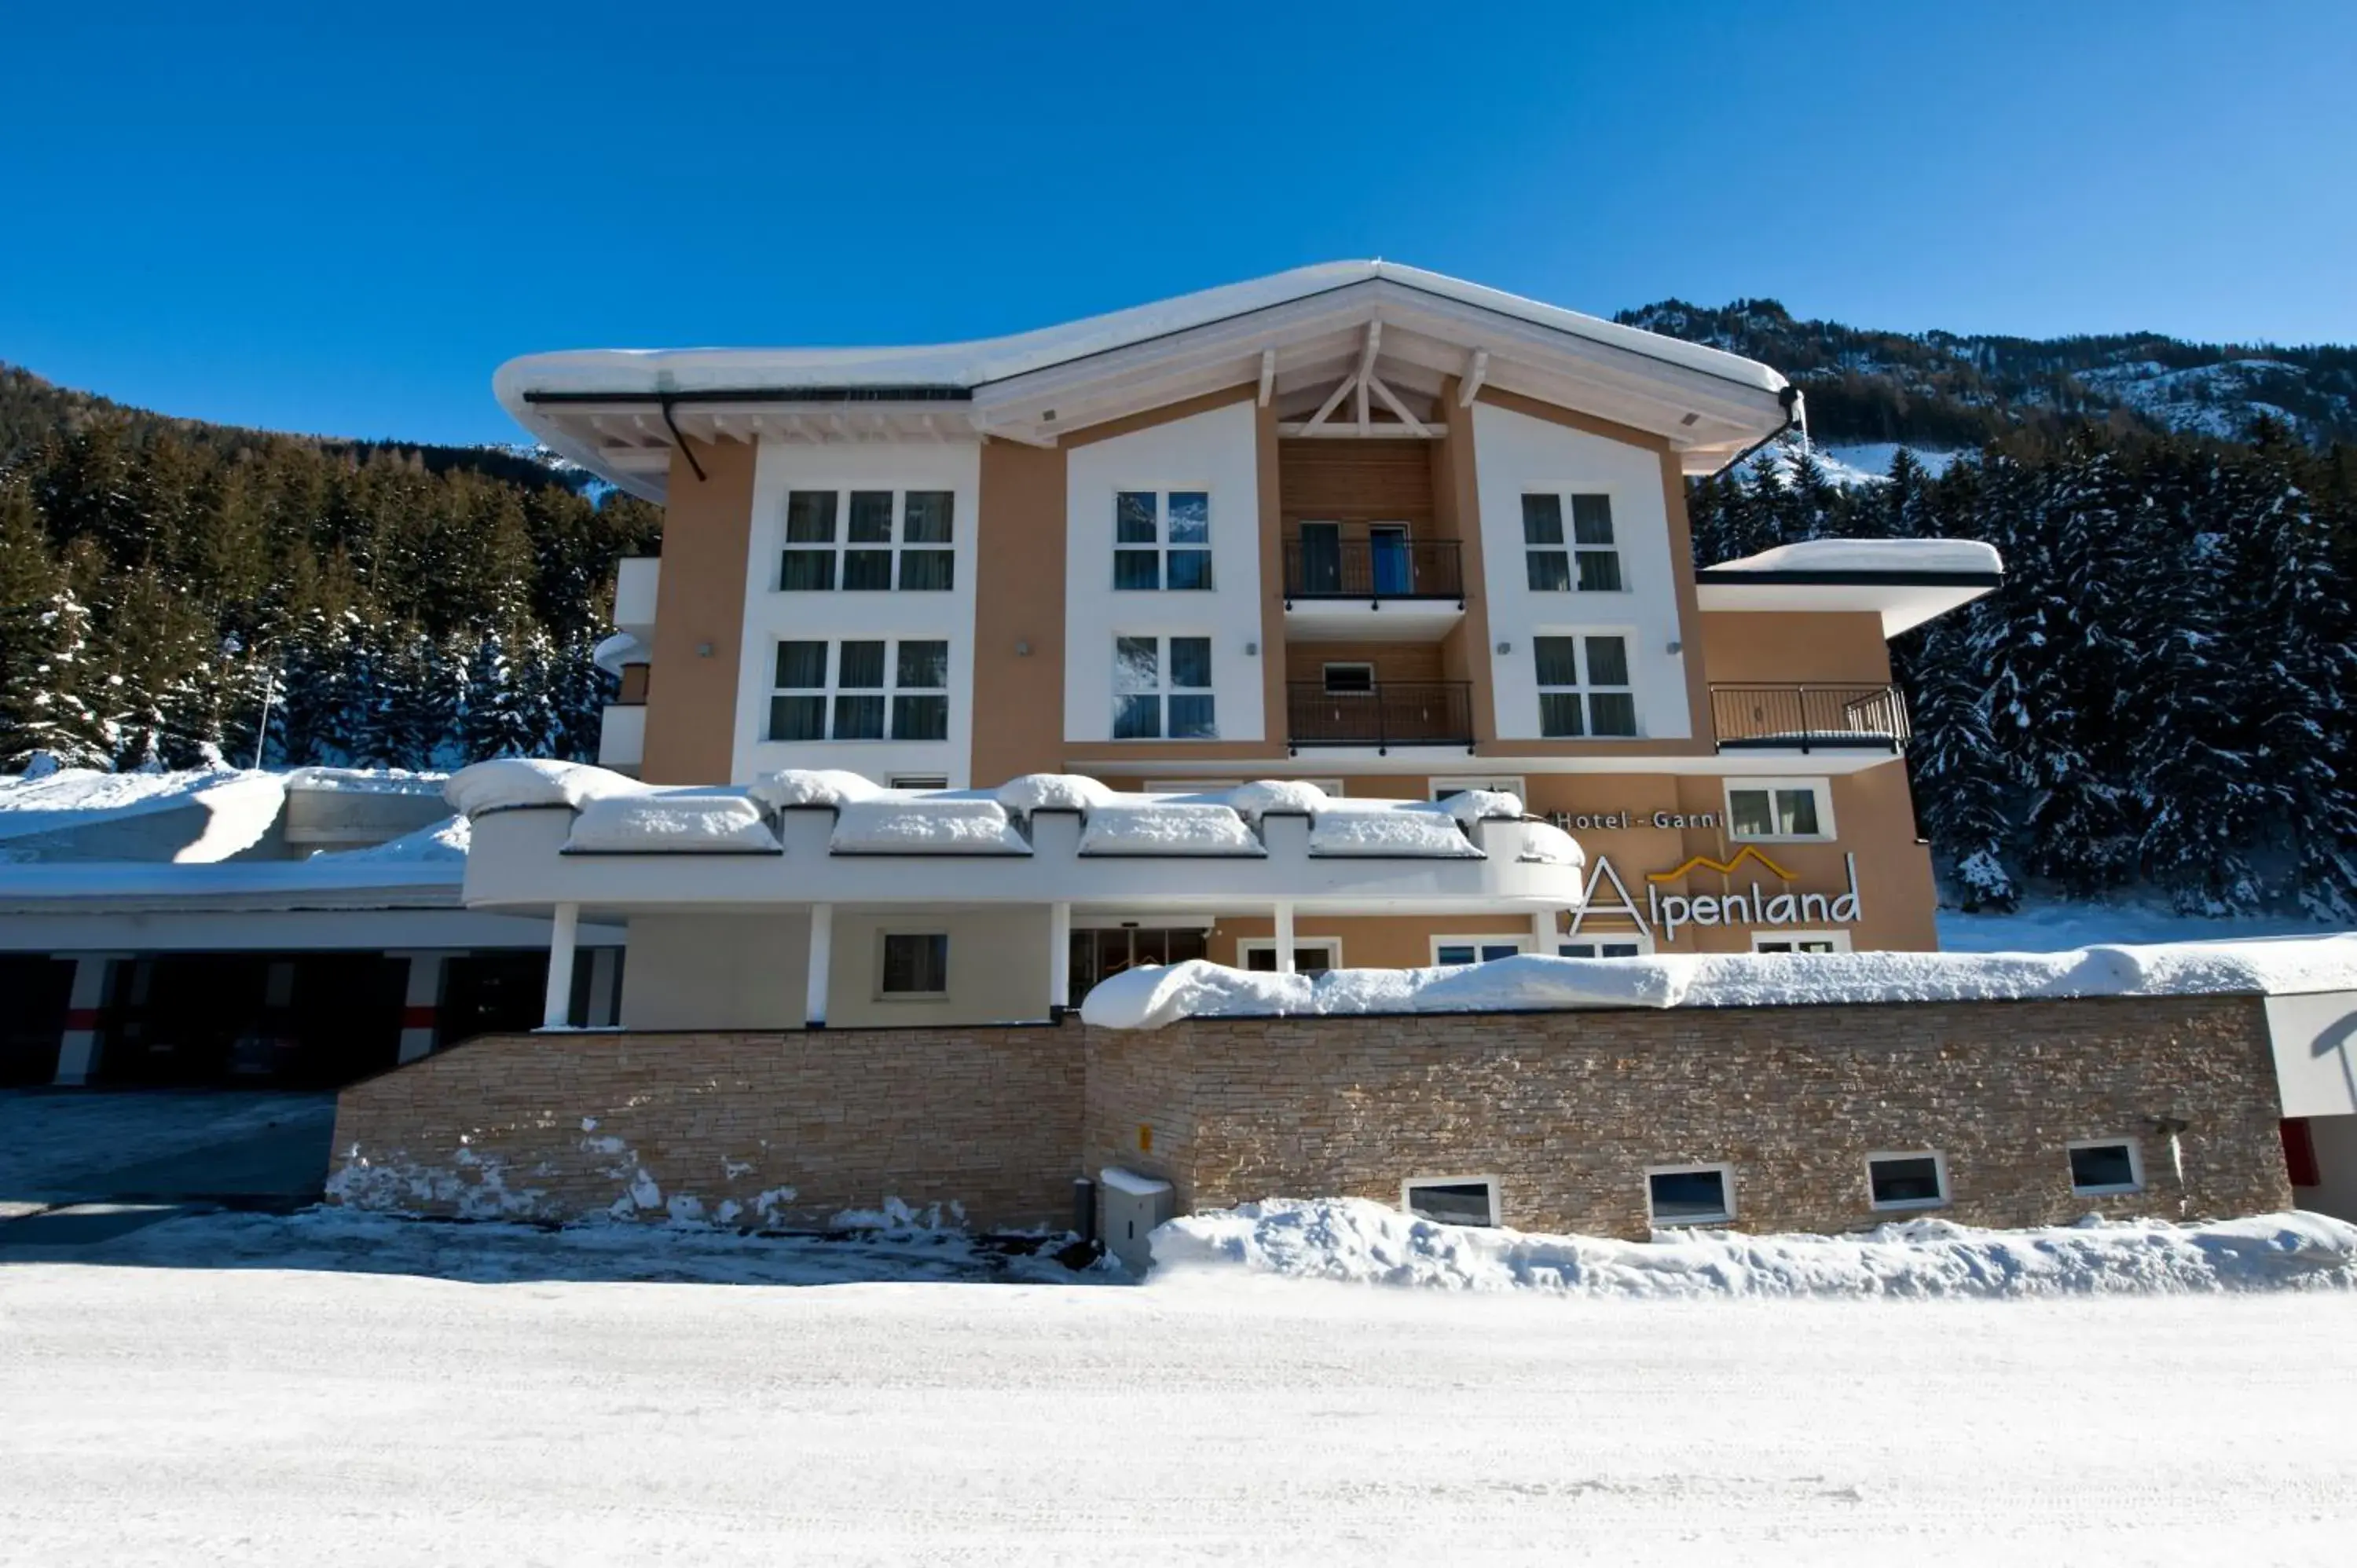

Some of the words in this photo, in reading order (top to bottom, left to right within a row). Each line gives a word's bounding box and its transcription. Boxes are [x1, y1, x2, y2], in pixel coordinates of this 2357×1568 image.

[1556, 811, 1629, 830] Hotel
[1653, 810, 1724, 830] Garni
[1570, 852, 1860, 941] Alpenland
